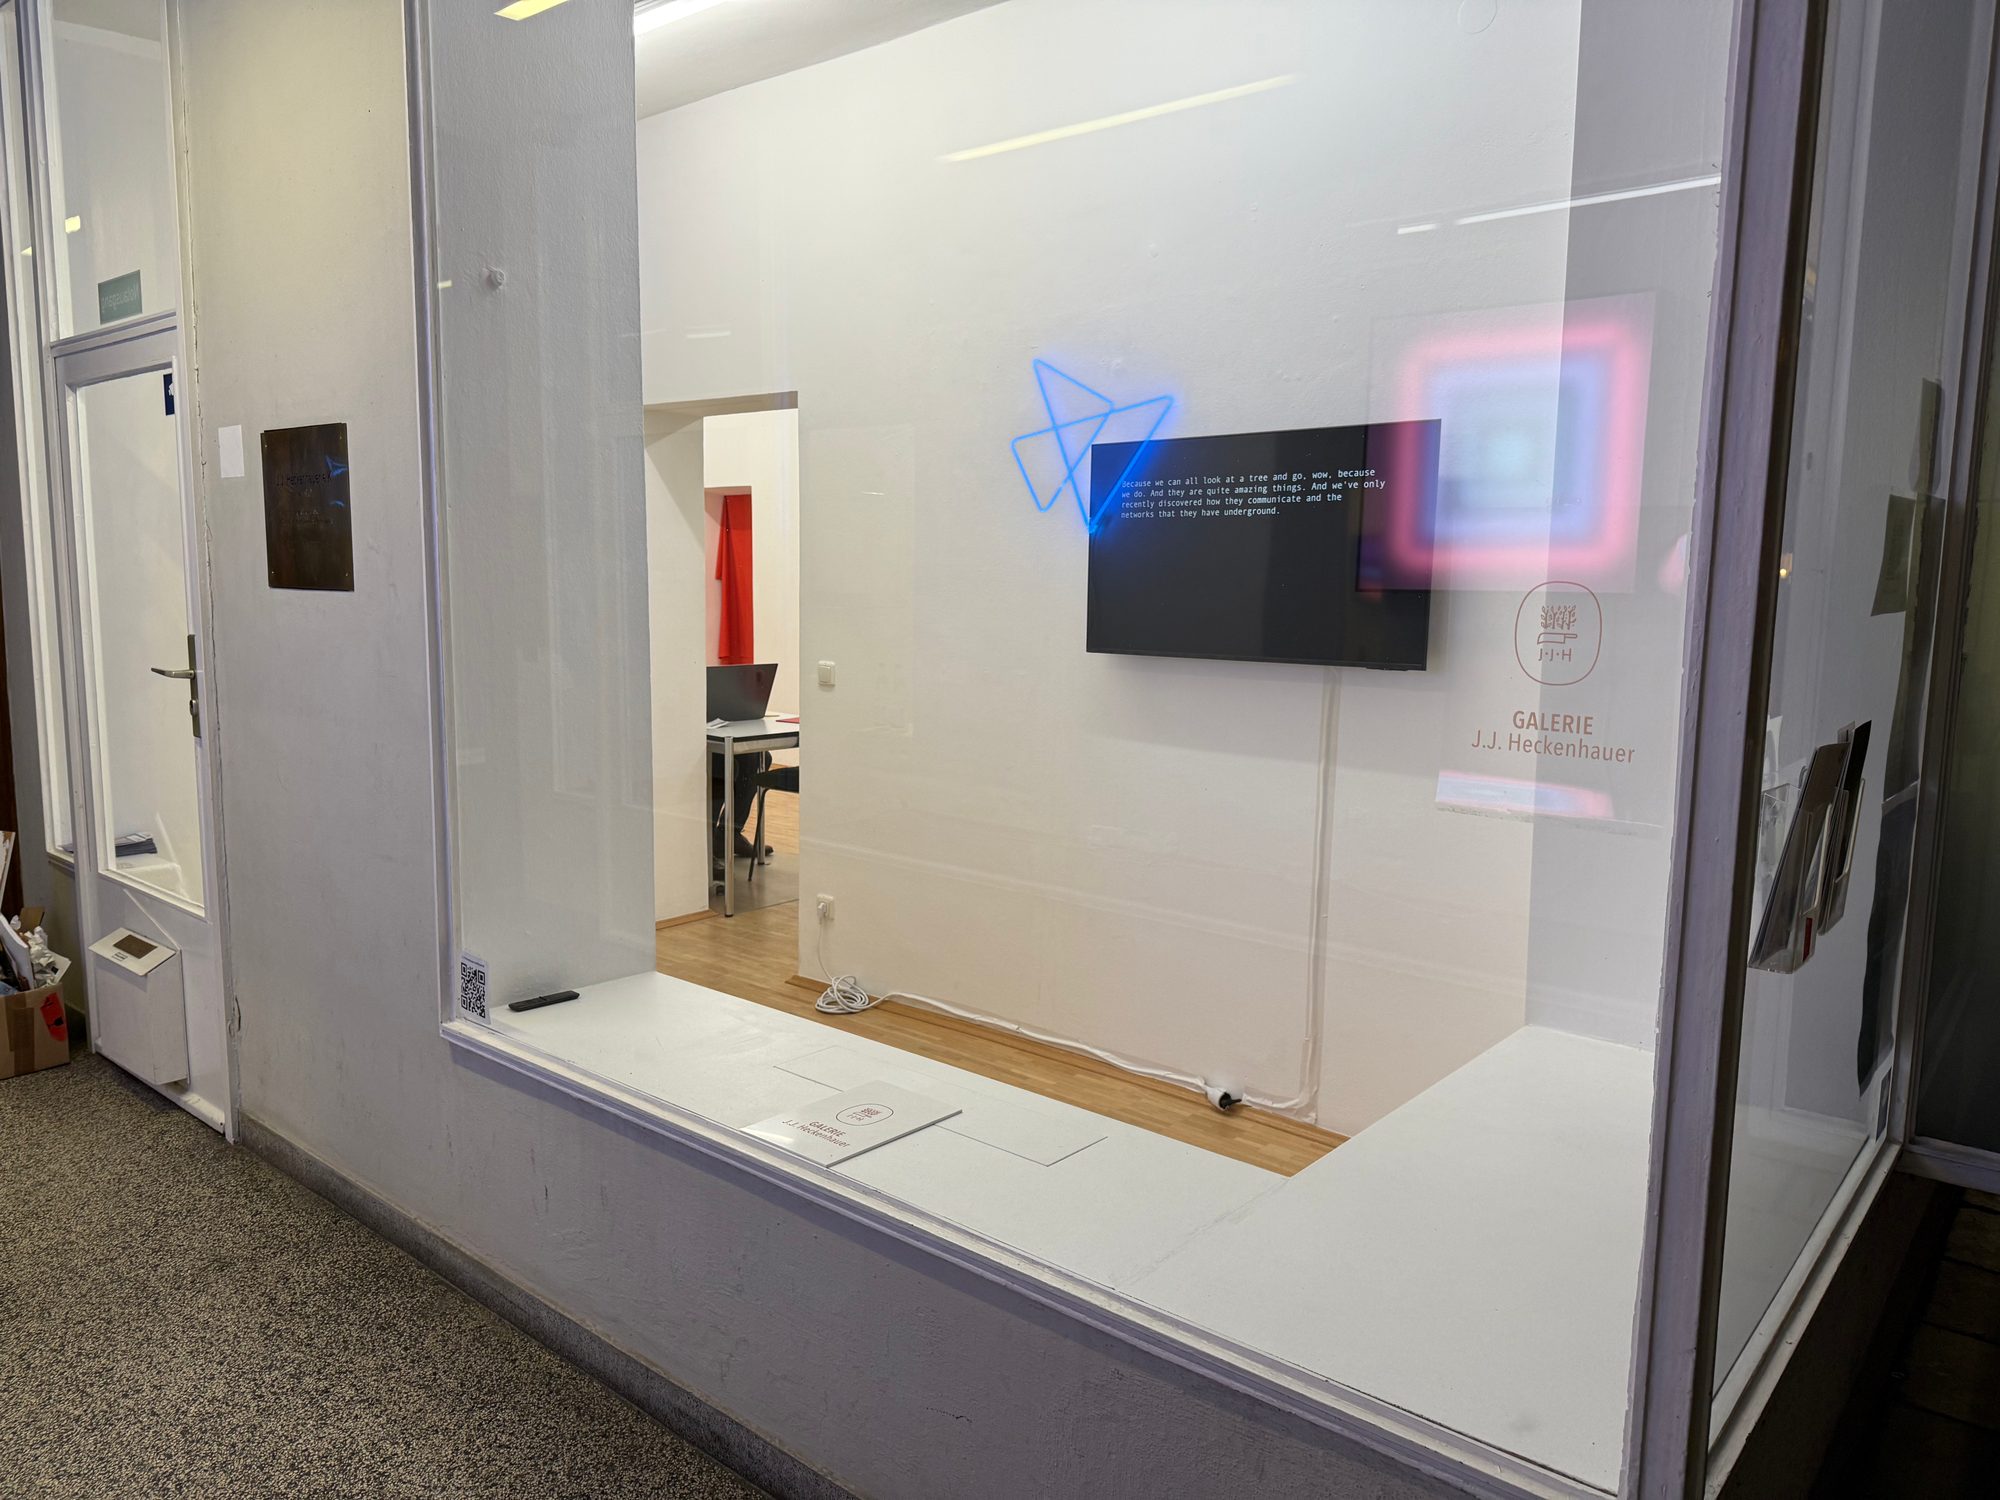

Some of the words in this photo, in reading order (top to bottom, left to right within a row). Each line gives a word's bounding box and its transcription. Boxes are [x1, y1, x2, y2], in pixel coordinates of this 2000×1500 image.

[1121, 480, 1151, 488] Because
[1185, 477, 1198, 485] all
[1203, 476, 1221, 484] look
[1225, 475, 1235, 483] at
[1239, 475, 1245, 483] a
[1249, 474, 1268, 482] tree
[1272, 472, 1288, 481] and
[1337, 469, 1375, 478] because
[1133, 490, 1146, 498] do.
[1150, 489, 1164, 497] And
[1167, 488, 1185, 498] they
[1189, 488, 1203, 496] are
[1206, 487, 1230, 496] quite
[1234, 485, 1268, 495] amazing
[1272, 483, 1306, 493] things.
[1311, 481, 1327, 490] And
[1331, 481, 1359, 489] we've
[1363, 479, 1386, 490] only
[1121, 499, 1155, 509] recently
[1158, 498, 1202, 507] discovered
[1206, 498, 1221, 506] how
[1225, 497, 1243, 506] they
[1247, 495, 1302, 504] communicate
[1306, 493, 1321, 502] and
[1327, 493, 1342, 501] the
[1121, 510, 1154, 519] networks
[1158, 509, 1175, 518] that
[1180, 509, 1197, 519] they
[1201, 508, 1220, 517] have
[1224, 507, 1280, 517] underground.
[1512, 710, 1594, 735] GALERIE
[1471, 729, 1502, 750] J.J.
[1508, 732, 1635, 763] Heckenhauer
[809, 1121, 846, 1137] GALERIE
